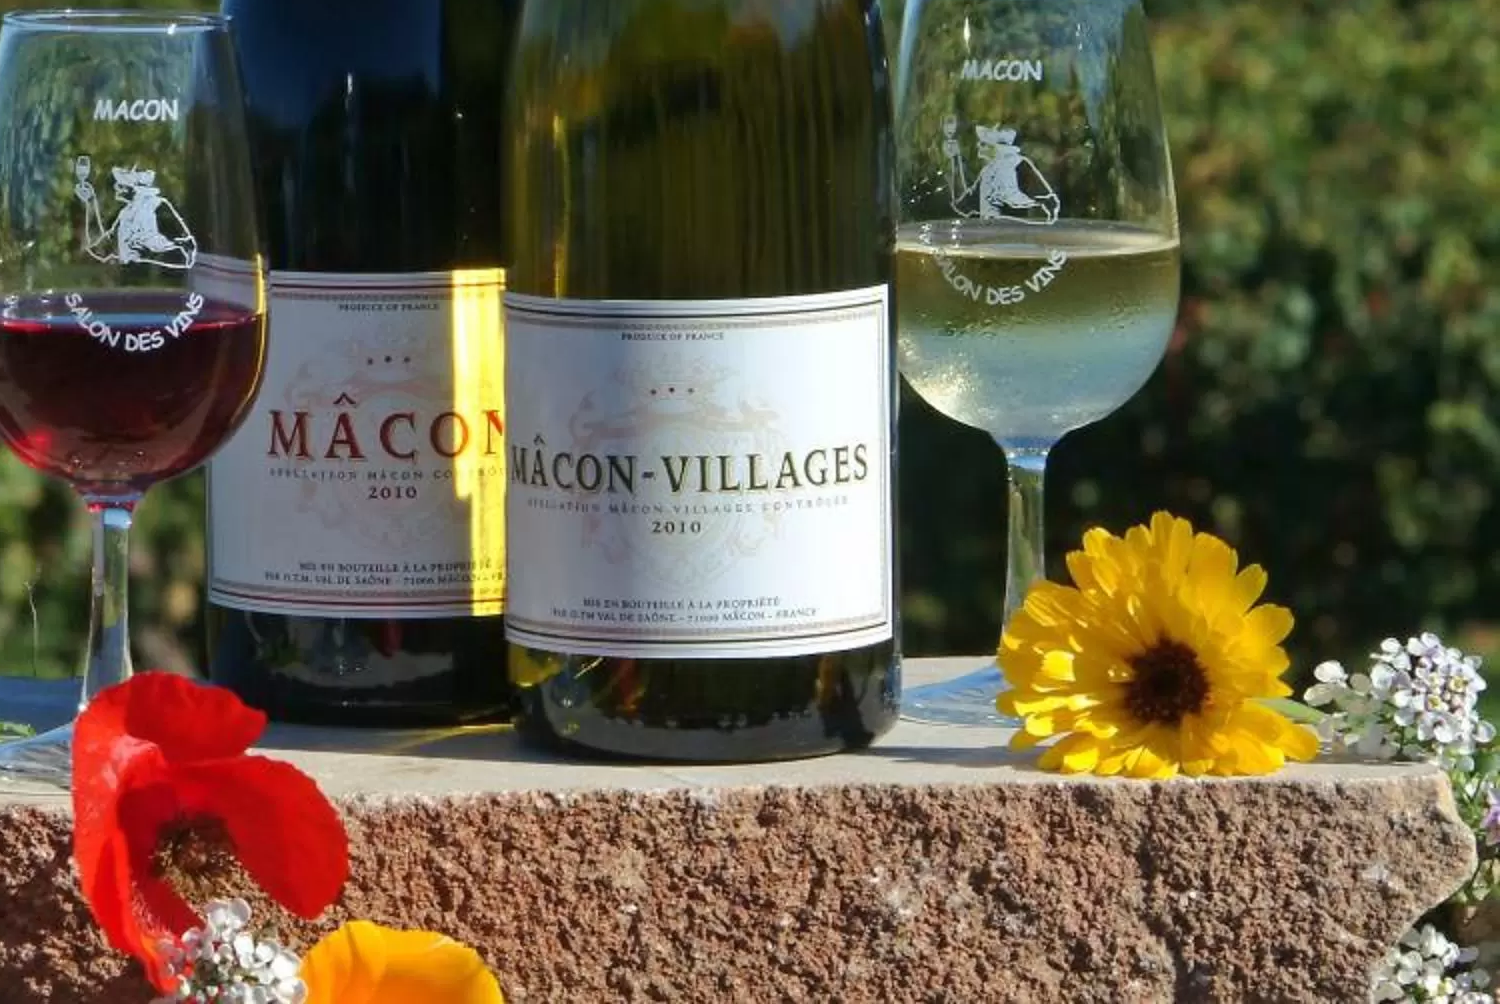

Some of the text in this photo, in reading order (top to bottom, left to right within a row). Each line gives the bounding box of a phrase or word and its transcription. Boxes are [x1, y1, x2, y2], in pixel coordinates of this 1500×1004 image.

[960, 59, 1044, 82] MACON
[93, 99, 180, 122] MACON
[986, 286, 1025, 306] DES
[1024, 248, 1068, 294] VINS
[65, 292, 204, 353] SALON DES VINS
[685, 331, 725, 342] FRANCE
[266, 391, 504, 462] MÂCON
[510, 434, 869, 494] MÂCON-VILLAGES
[367, 485, 418, 500] 2010
[651, 520, 702, 535] 2010
